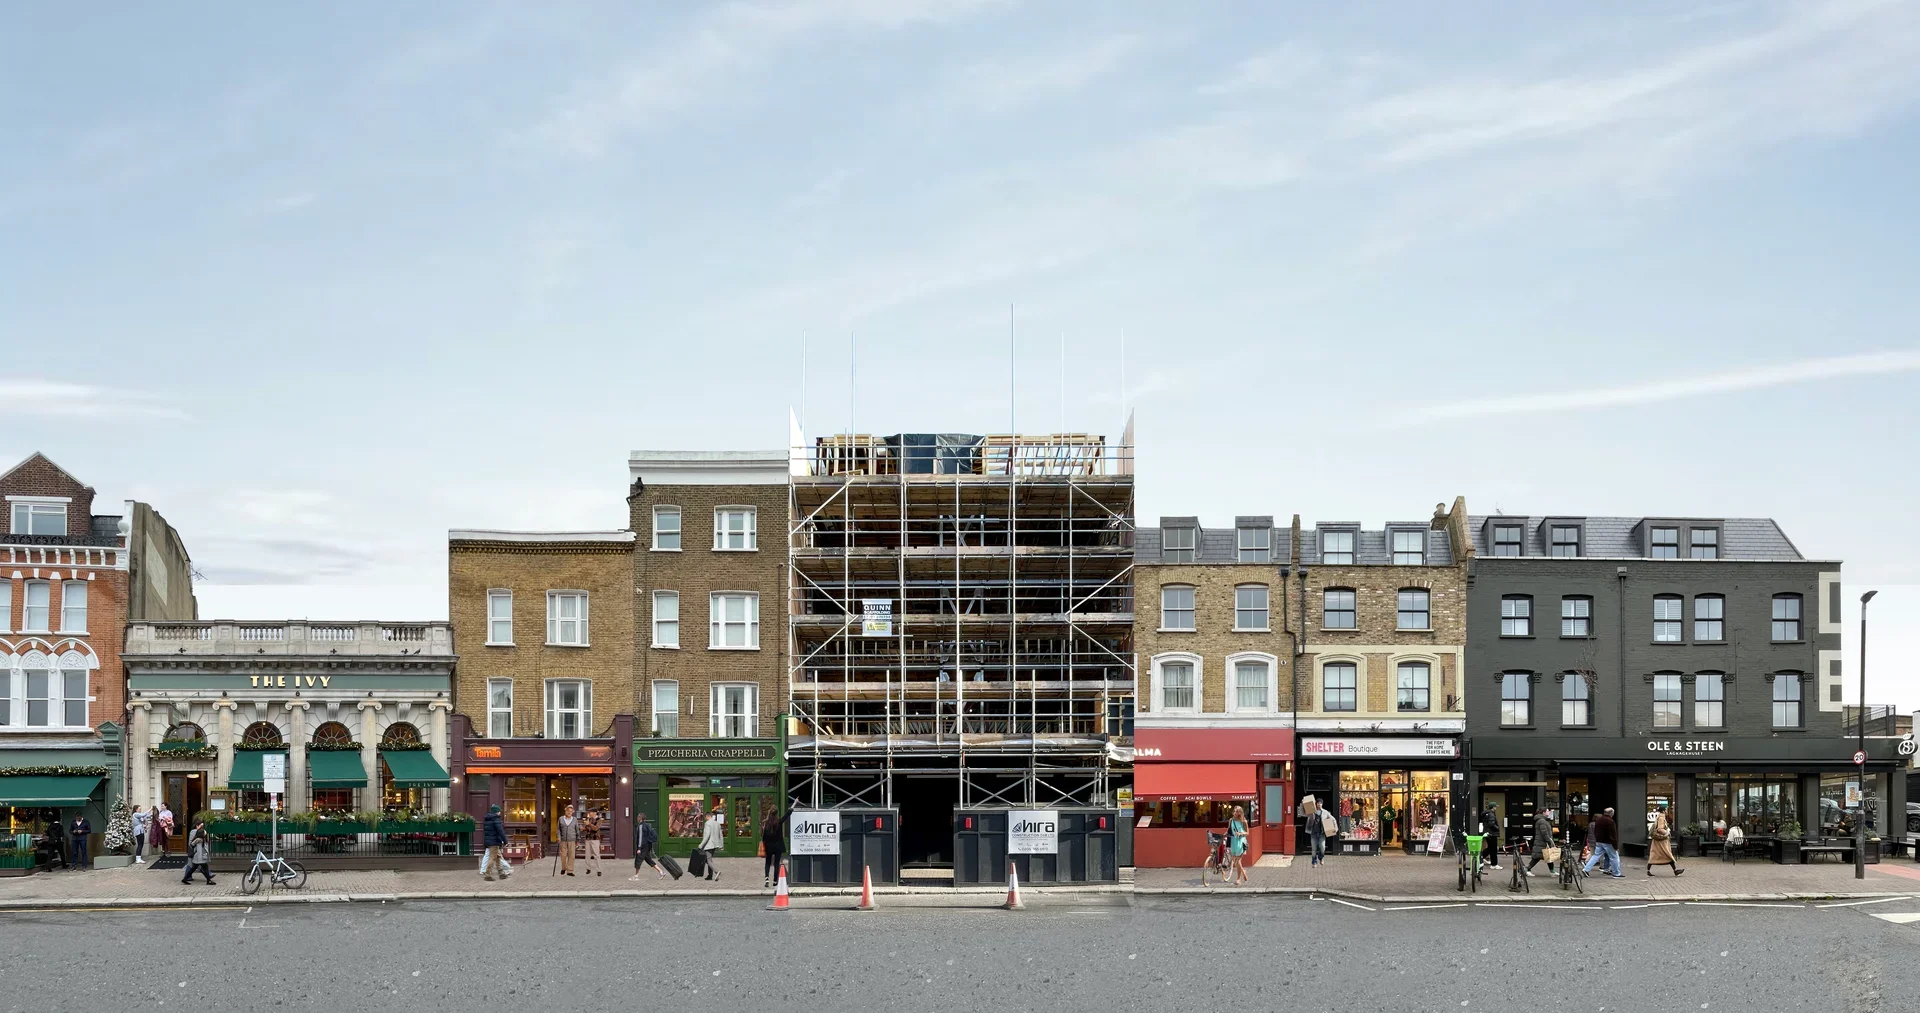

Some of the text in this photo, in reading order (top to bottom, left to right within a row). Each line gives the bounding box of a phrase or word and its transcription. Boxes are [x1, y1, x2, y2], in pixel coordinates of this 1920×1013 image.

[250, 675, 331, 688] THE IVY
[1306, 742, 1378, 754] SHELTER Boutique
[1647, 741, 1724, 751] OLE & STEEN
[474, 748, 502, 758] Tamila
[648, 749, 766, 758] PIZZICHERIA GRAPPELLI
[804, 820, 837, 834] hira
[1023, 819, 1055, 833] hira
